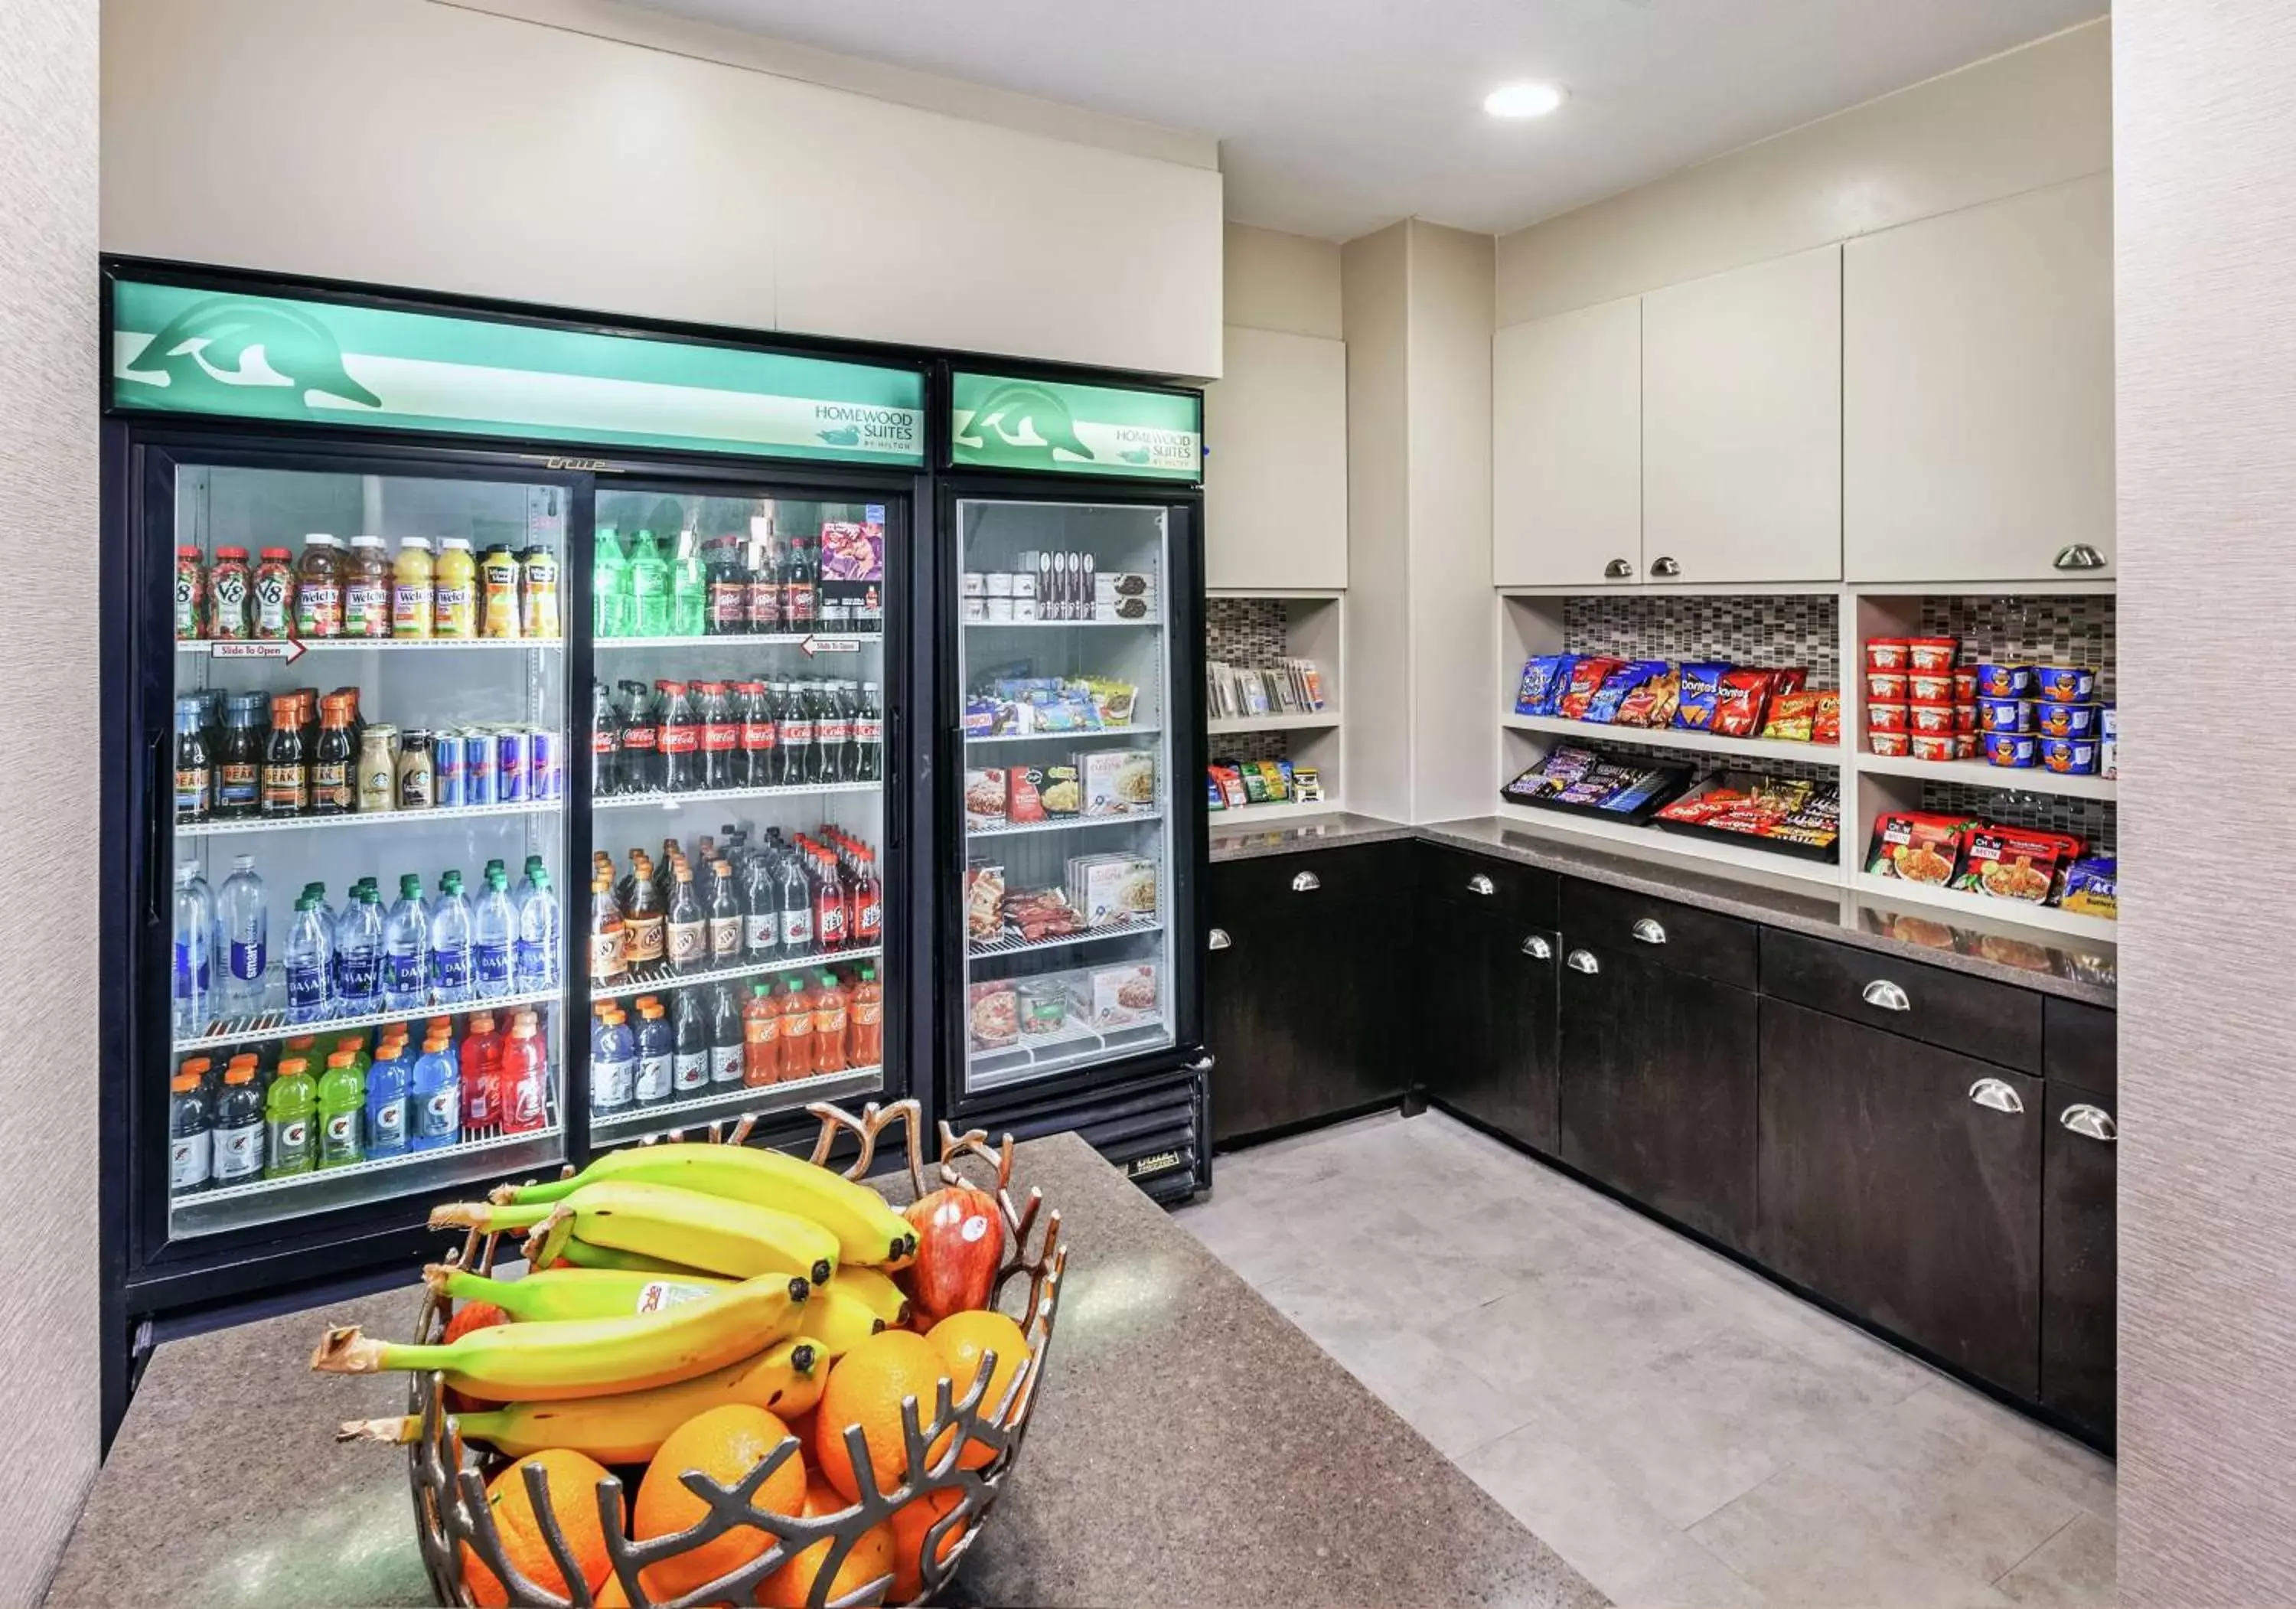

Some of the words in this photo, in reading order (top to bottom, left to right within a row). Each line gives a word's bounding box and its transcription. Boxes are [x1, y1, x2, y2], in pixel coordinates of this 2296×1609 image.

[815, 405, 913, 426] HOMEWOOD
[864, 424, 912, 440] SUITES
[1116, 429, 1191, 446] HOMEWOOD
[1153, 445, 1191, 459] SUITES
[217, 579, 243, 603] V8
[256, 579, 282, 604] V8
[221, 647, 244, 655] Slide
[246, 647, 256, 655] To
[256, 648, 281, 656] Open
[1681, 679, 1717, 694] Doritos
[225, 768, 256, 780] PEAK
